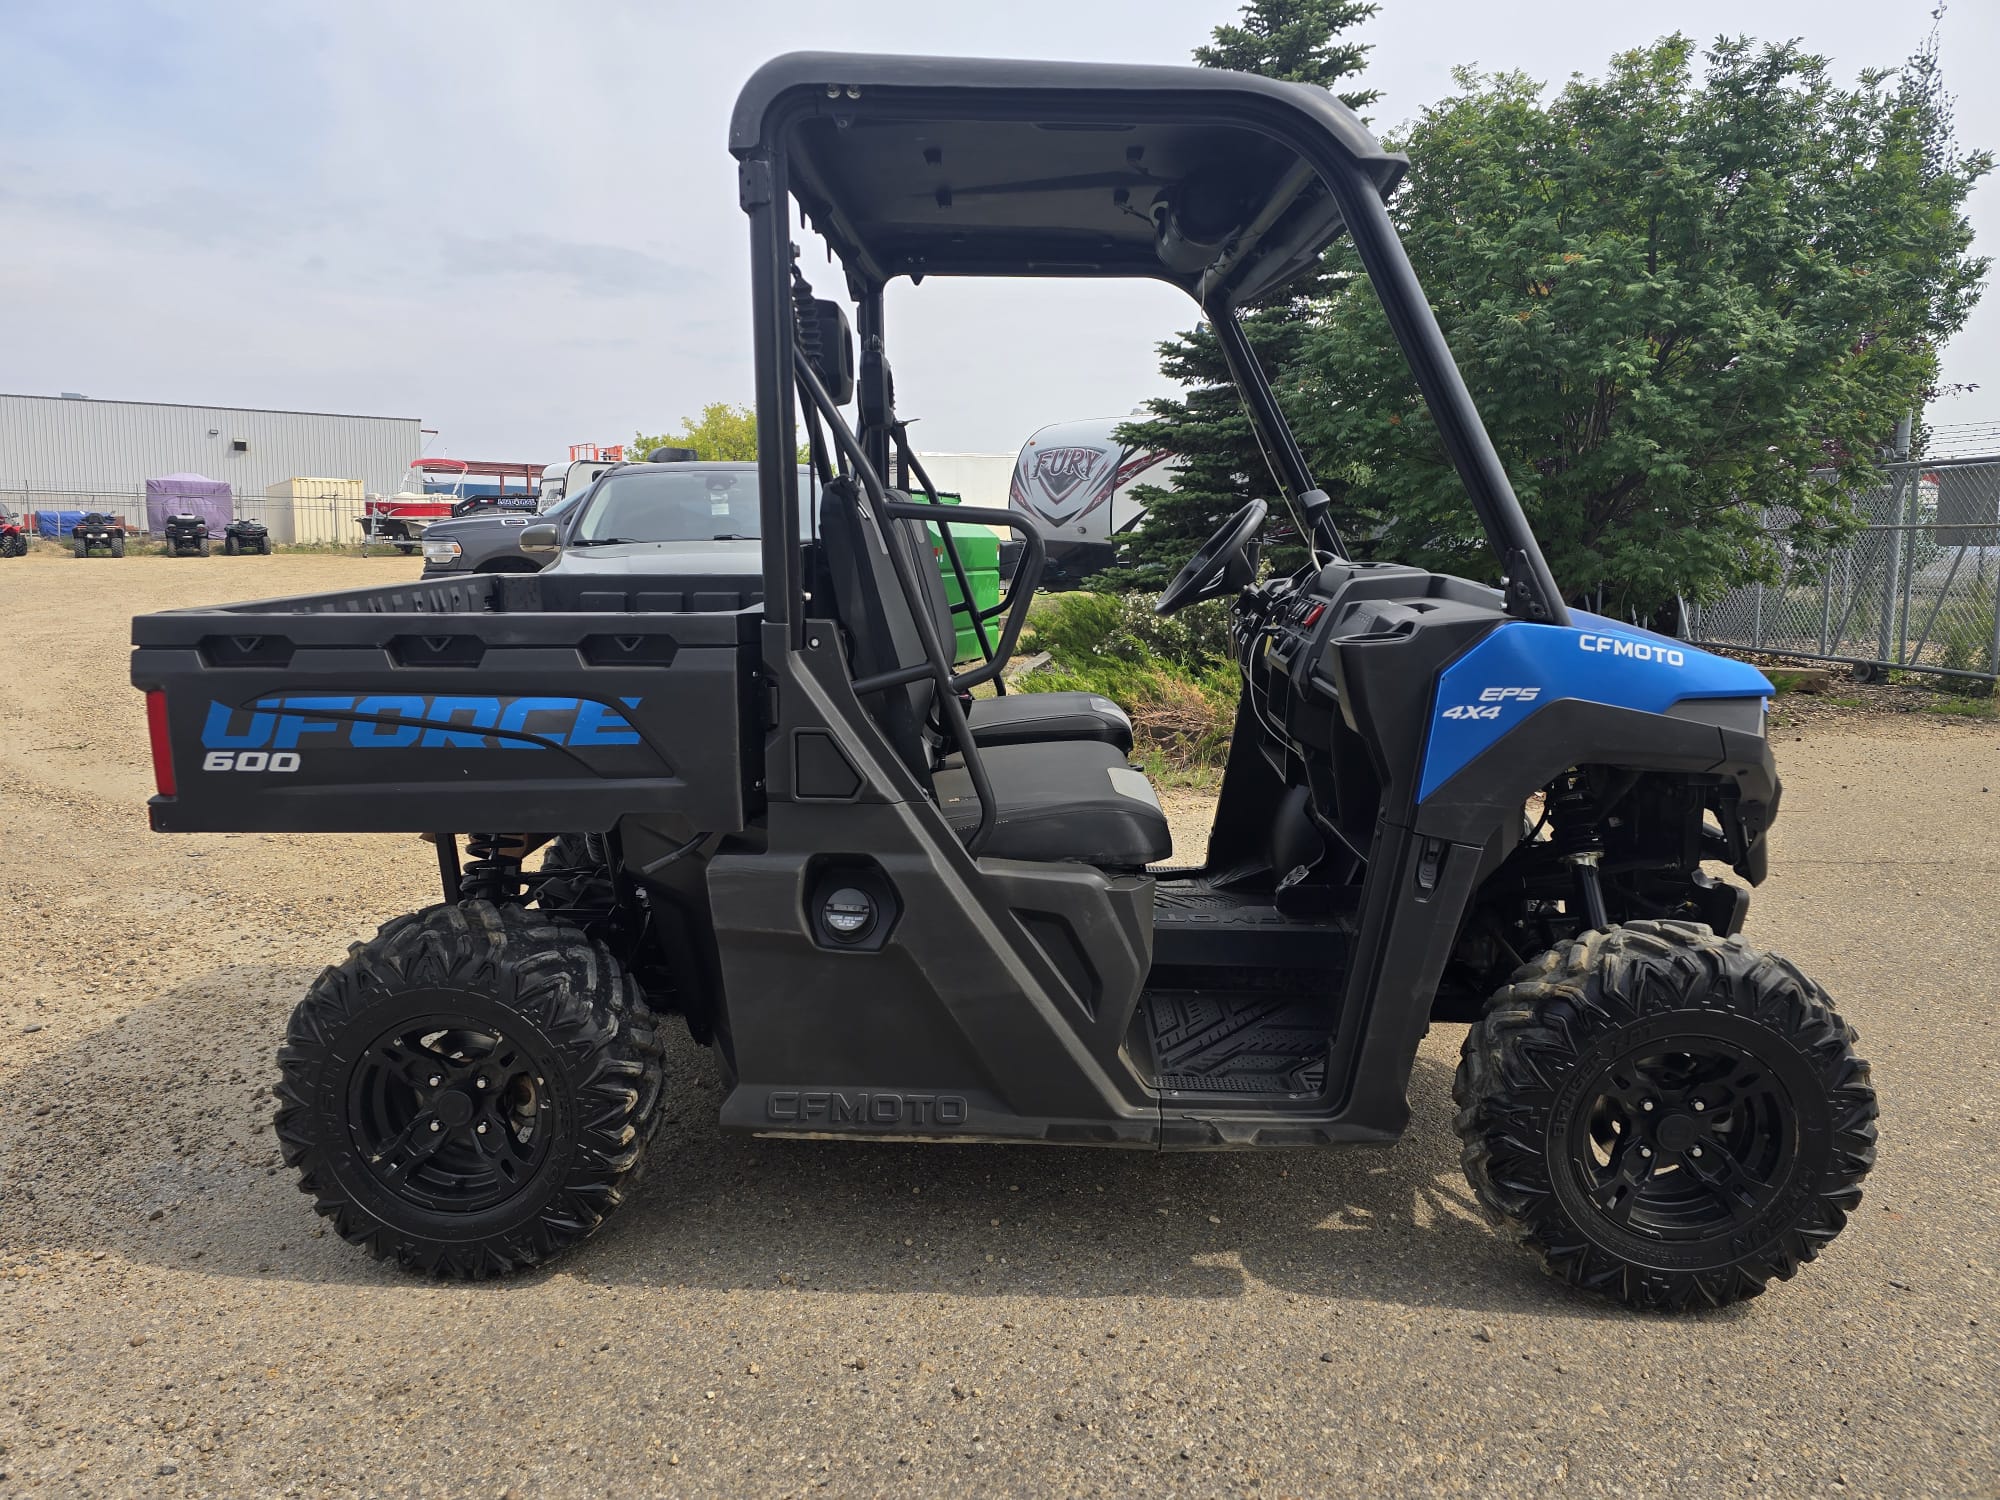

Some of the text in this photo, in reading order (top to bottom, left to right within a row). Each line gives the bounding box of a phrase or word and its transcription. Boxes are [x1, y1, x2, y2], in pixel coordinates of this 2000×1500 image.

[1029, 448, 1103, 480] FURY
[1579, 634, 1685, 667] CFMOTO
[1479, 687, 1541, 702] EPS
[201, 695, 645, 750] UFORCE
[1442, 705, 1502, 720] 4X4
[203, 751, 301, 772] 600
[768, 1091, 968, 1124] CFMOTO
